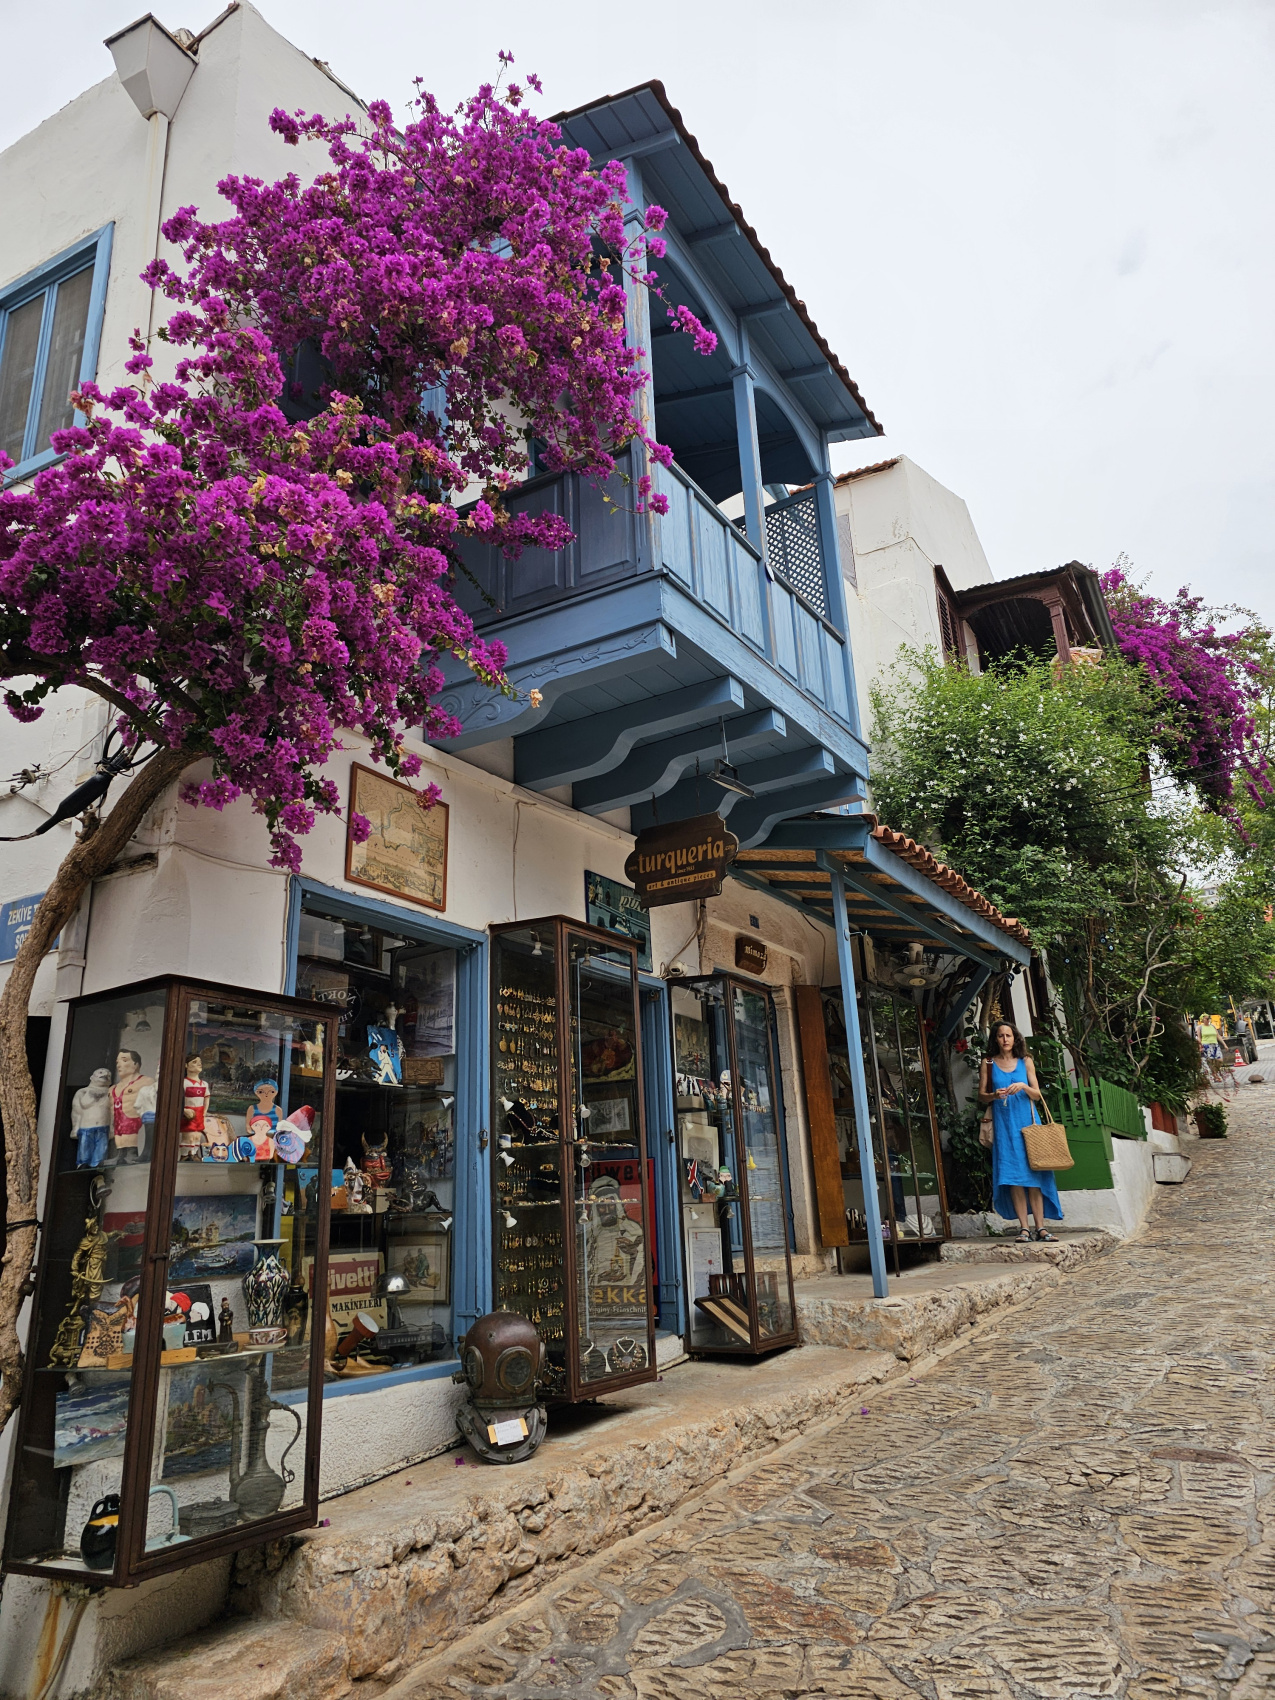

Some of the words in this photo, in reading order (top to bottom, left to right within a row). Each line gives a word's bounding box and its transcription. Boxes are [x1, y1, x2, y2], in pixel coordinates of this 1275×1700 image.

[639, 836, 724, 874] turqueria
[667, 877, 691, 886] antique
[693, 872, 714, 881] pieces
[8, 905, 32, 925] ZEKİYE
[328, 1266, 375, 1290] ivetti
